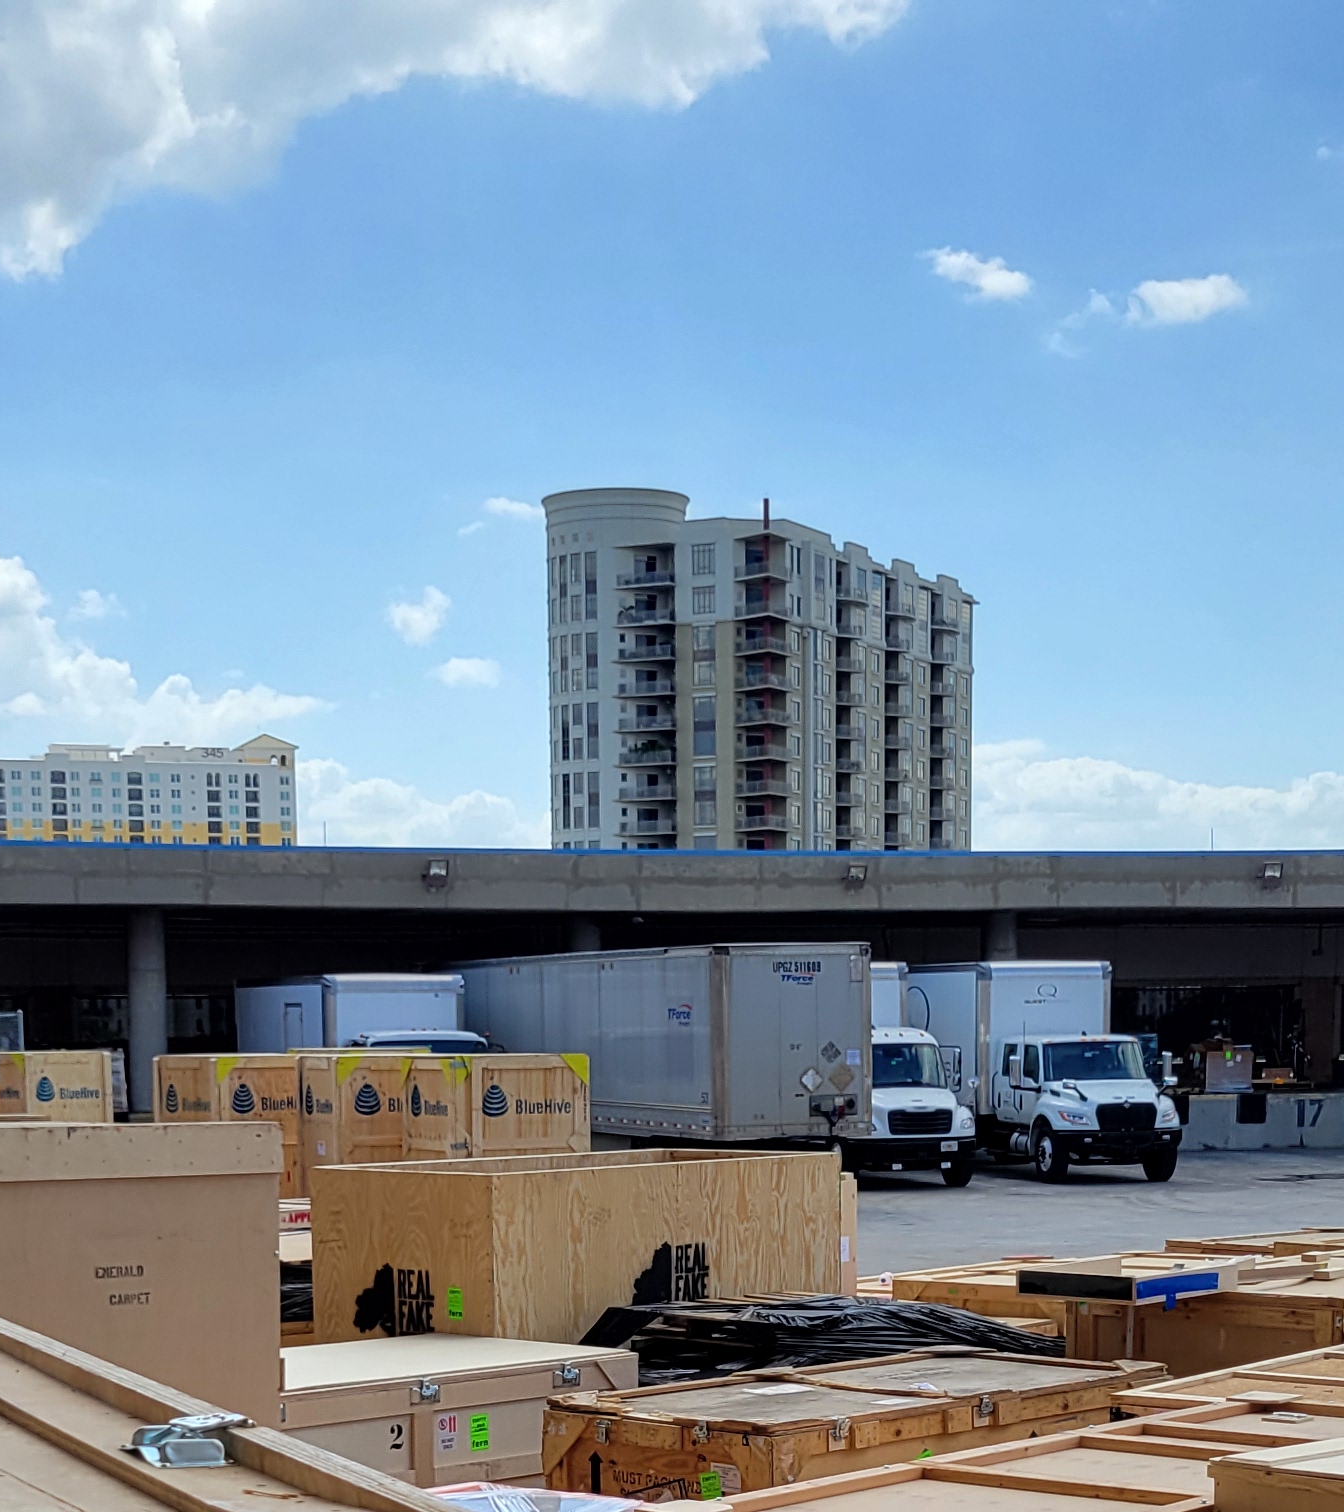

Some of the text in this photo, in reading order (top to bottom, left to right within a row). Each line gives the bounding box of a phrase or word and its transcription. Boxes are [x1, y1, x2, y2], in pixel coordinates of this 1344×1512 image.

[667, 1008, 692, 1020] TForce
[59, 1087, 101, 1100] BlueHive
[515, 1099, 571, 1115] BlueHive
[1295, 1099, 1325, 1128] 17
[675, 1242, 709, 1274] REAL
[95, 1265, 144, 1279] EMERALD
[397, 1268, 435, 1300] REAL
[675, 1272, 709, 1301] FAKE
[109, 1292, 151, 1306] CARPET
[398, 1300, 436, 1333] FAKE
[390, 1423, 405, 1451] 2
[472, 1440, 489, 1449] fern
[613, 1469, 643, 1486] MUST
